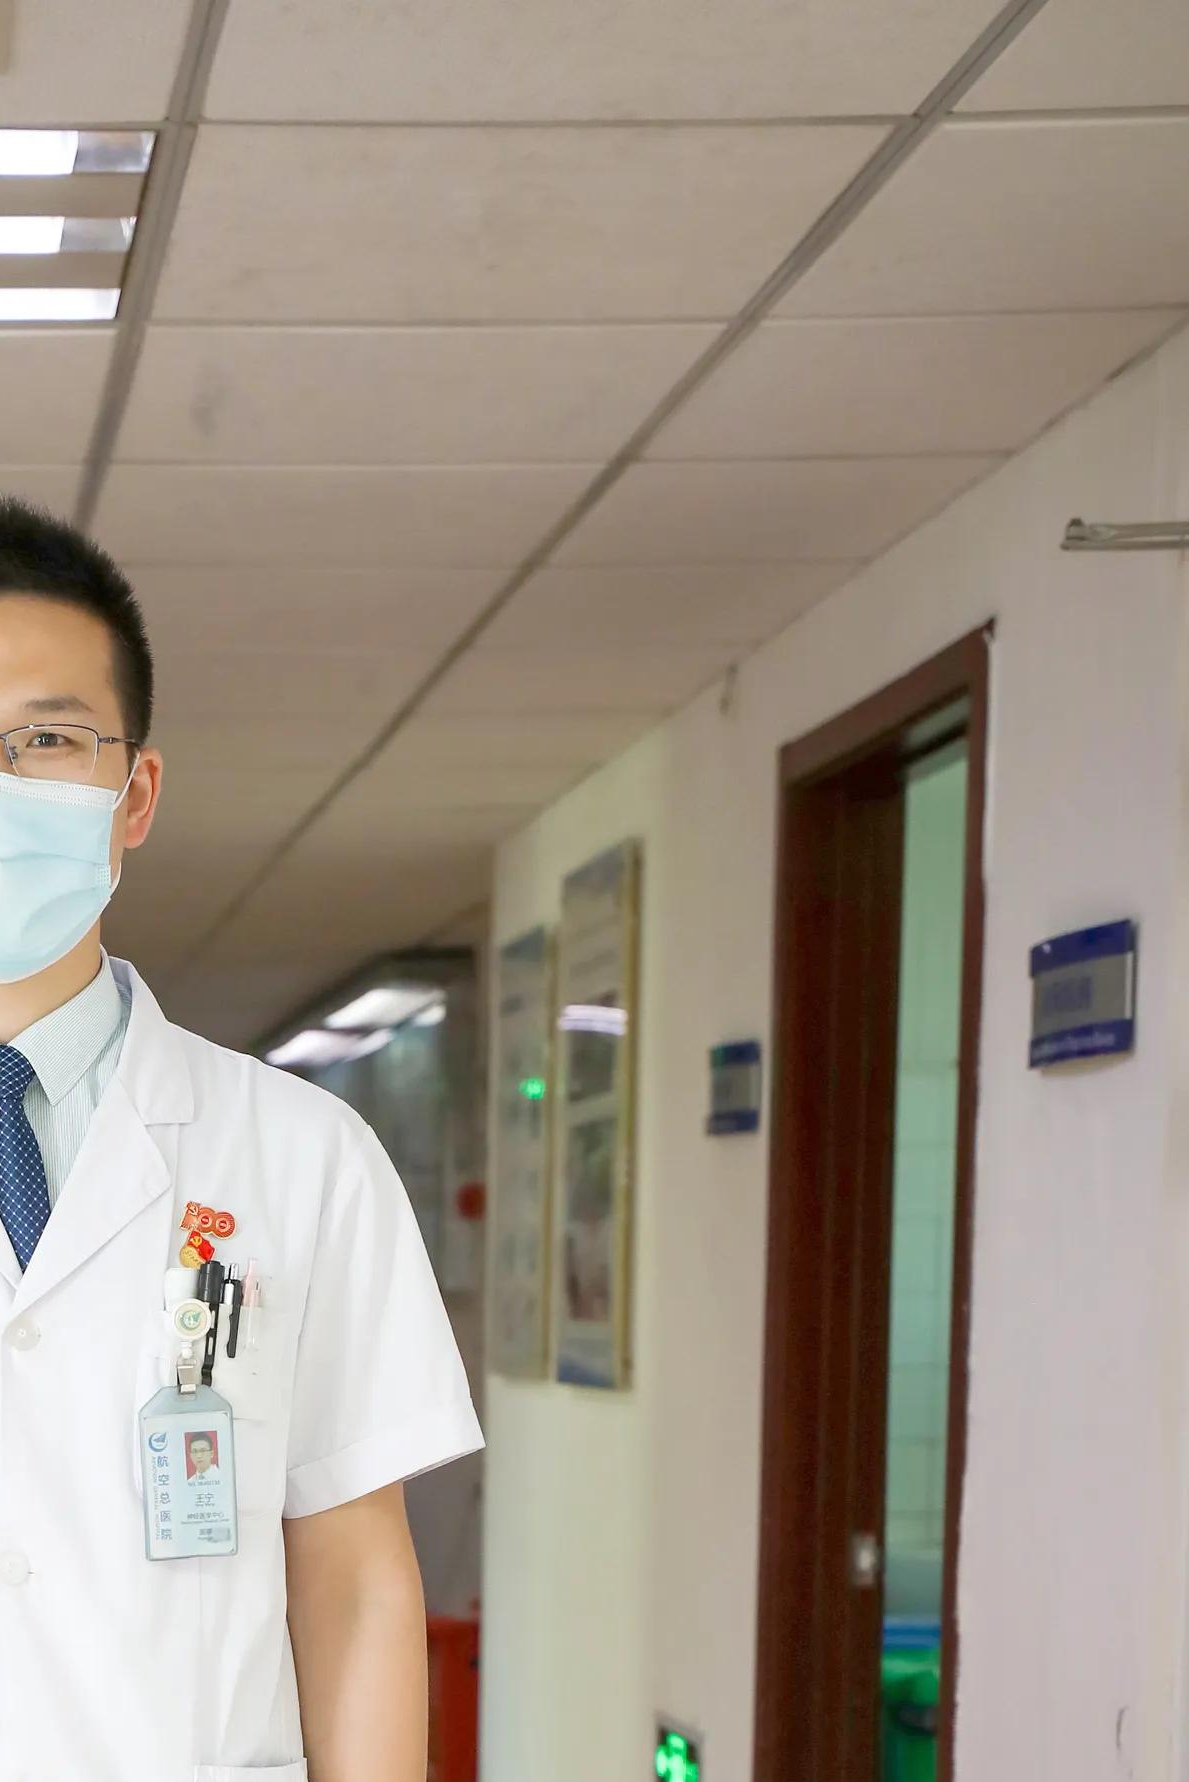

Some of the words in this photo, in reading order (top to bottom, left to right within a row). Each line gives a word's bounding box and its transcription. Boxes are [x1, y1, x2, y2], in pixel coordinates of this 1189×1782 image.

[157, 1455, 172, 1541] 航空总医院
[195, 1492, 214, 1503] 王宁
